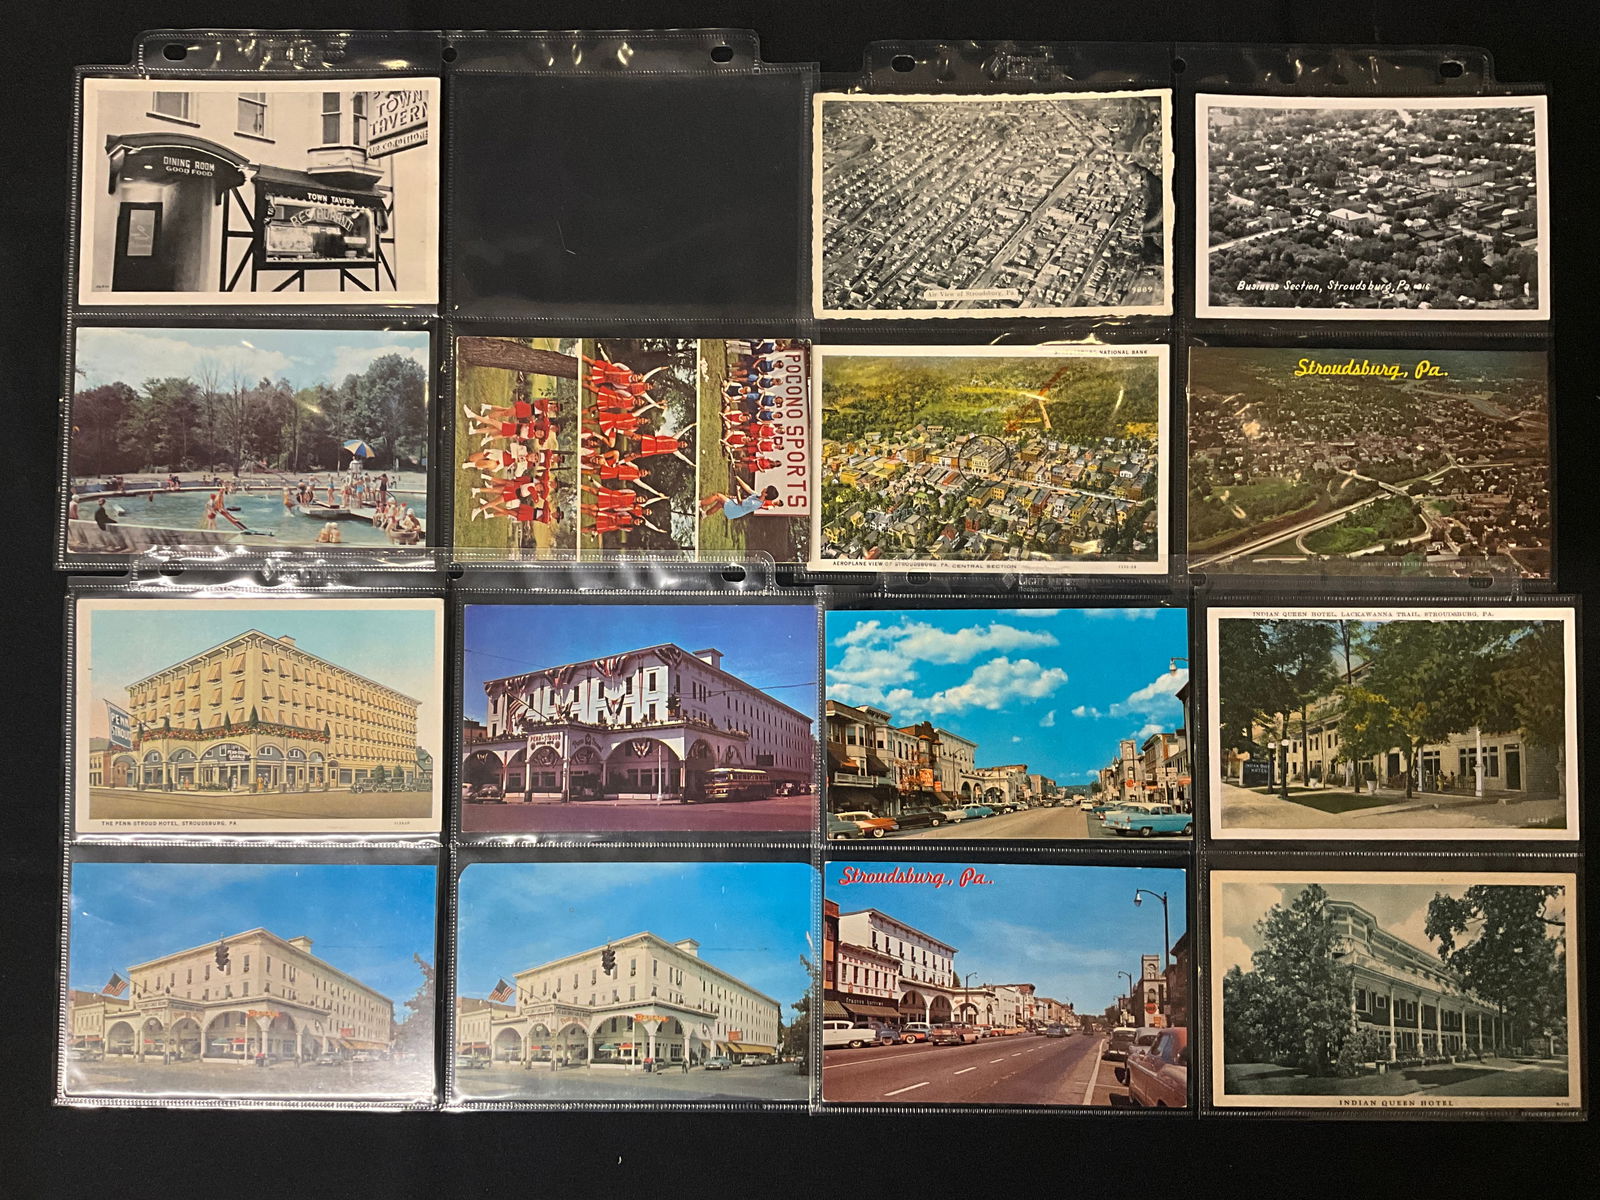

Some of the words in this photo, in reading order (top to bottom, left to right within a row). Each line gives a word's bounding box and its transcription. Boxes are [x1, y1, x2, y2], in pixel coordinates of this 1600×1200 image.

[164, 156, 190, 168] DINING
[194, 160, 215, 172] ROOM
[166, 166, 190, 174] GOOD
[307, 192, 328, 202] TOWN
[330, 196, 354, 205] TAVERN
[1236, 280, 1280, 290] Business
[1284, 280, 1322, 293] Section,
[1327, 280, 1395, 294] Stroudsburg,
[1294, 358, 1408, 380] Stroudsburg,
[1414, 360, 1449, 380] Pa.
[785, 354, 804, 418] POCONO
[786, 426, 807, 508] SPORTS
[838, 866, 954, 888] Stroudsburg,
[959, 867, 994, 888] Pa.
